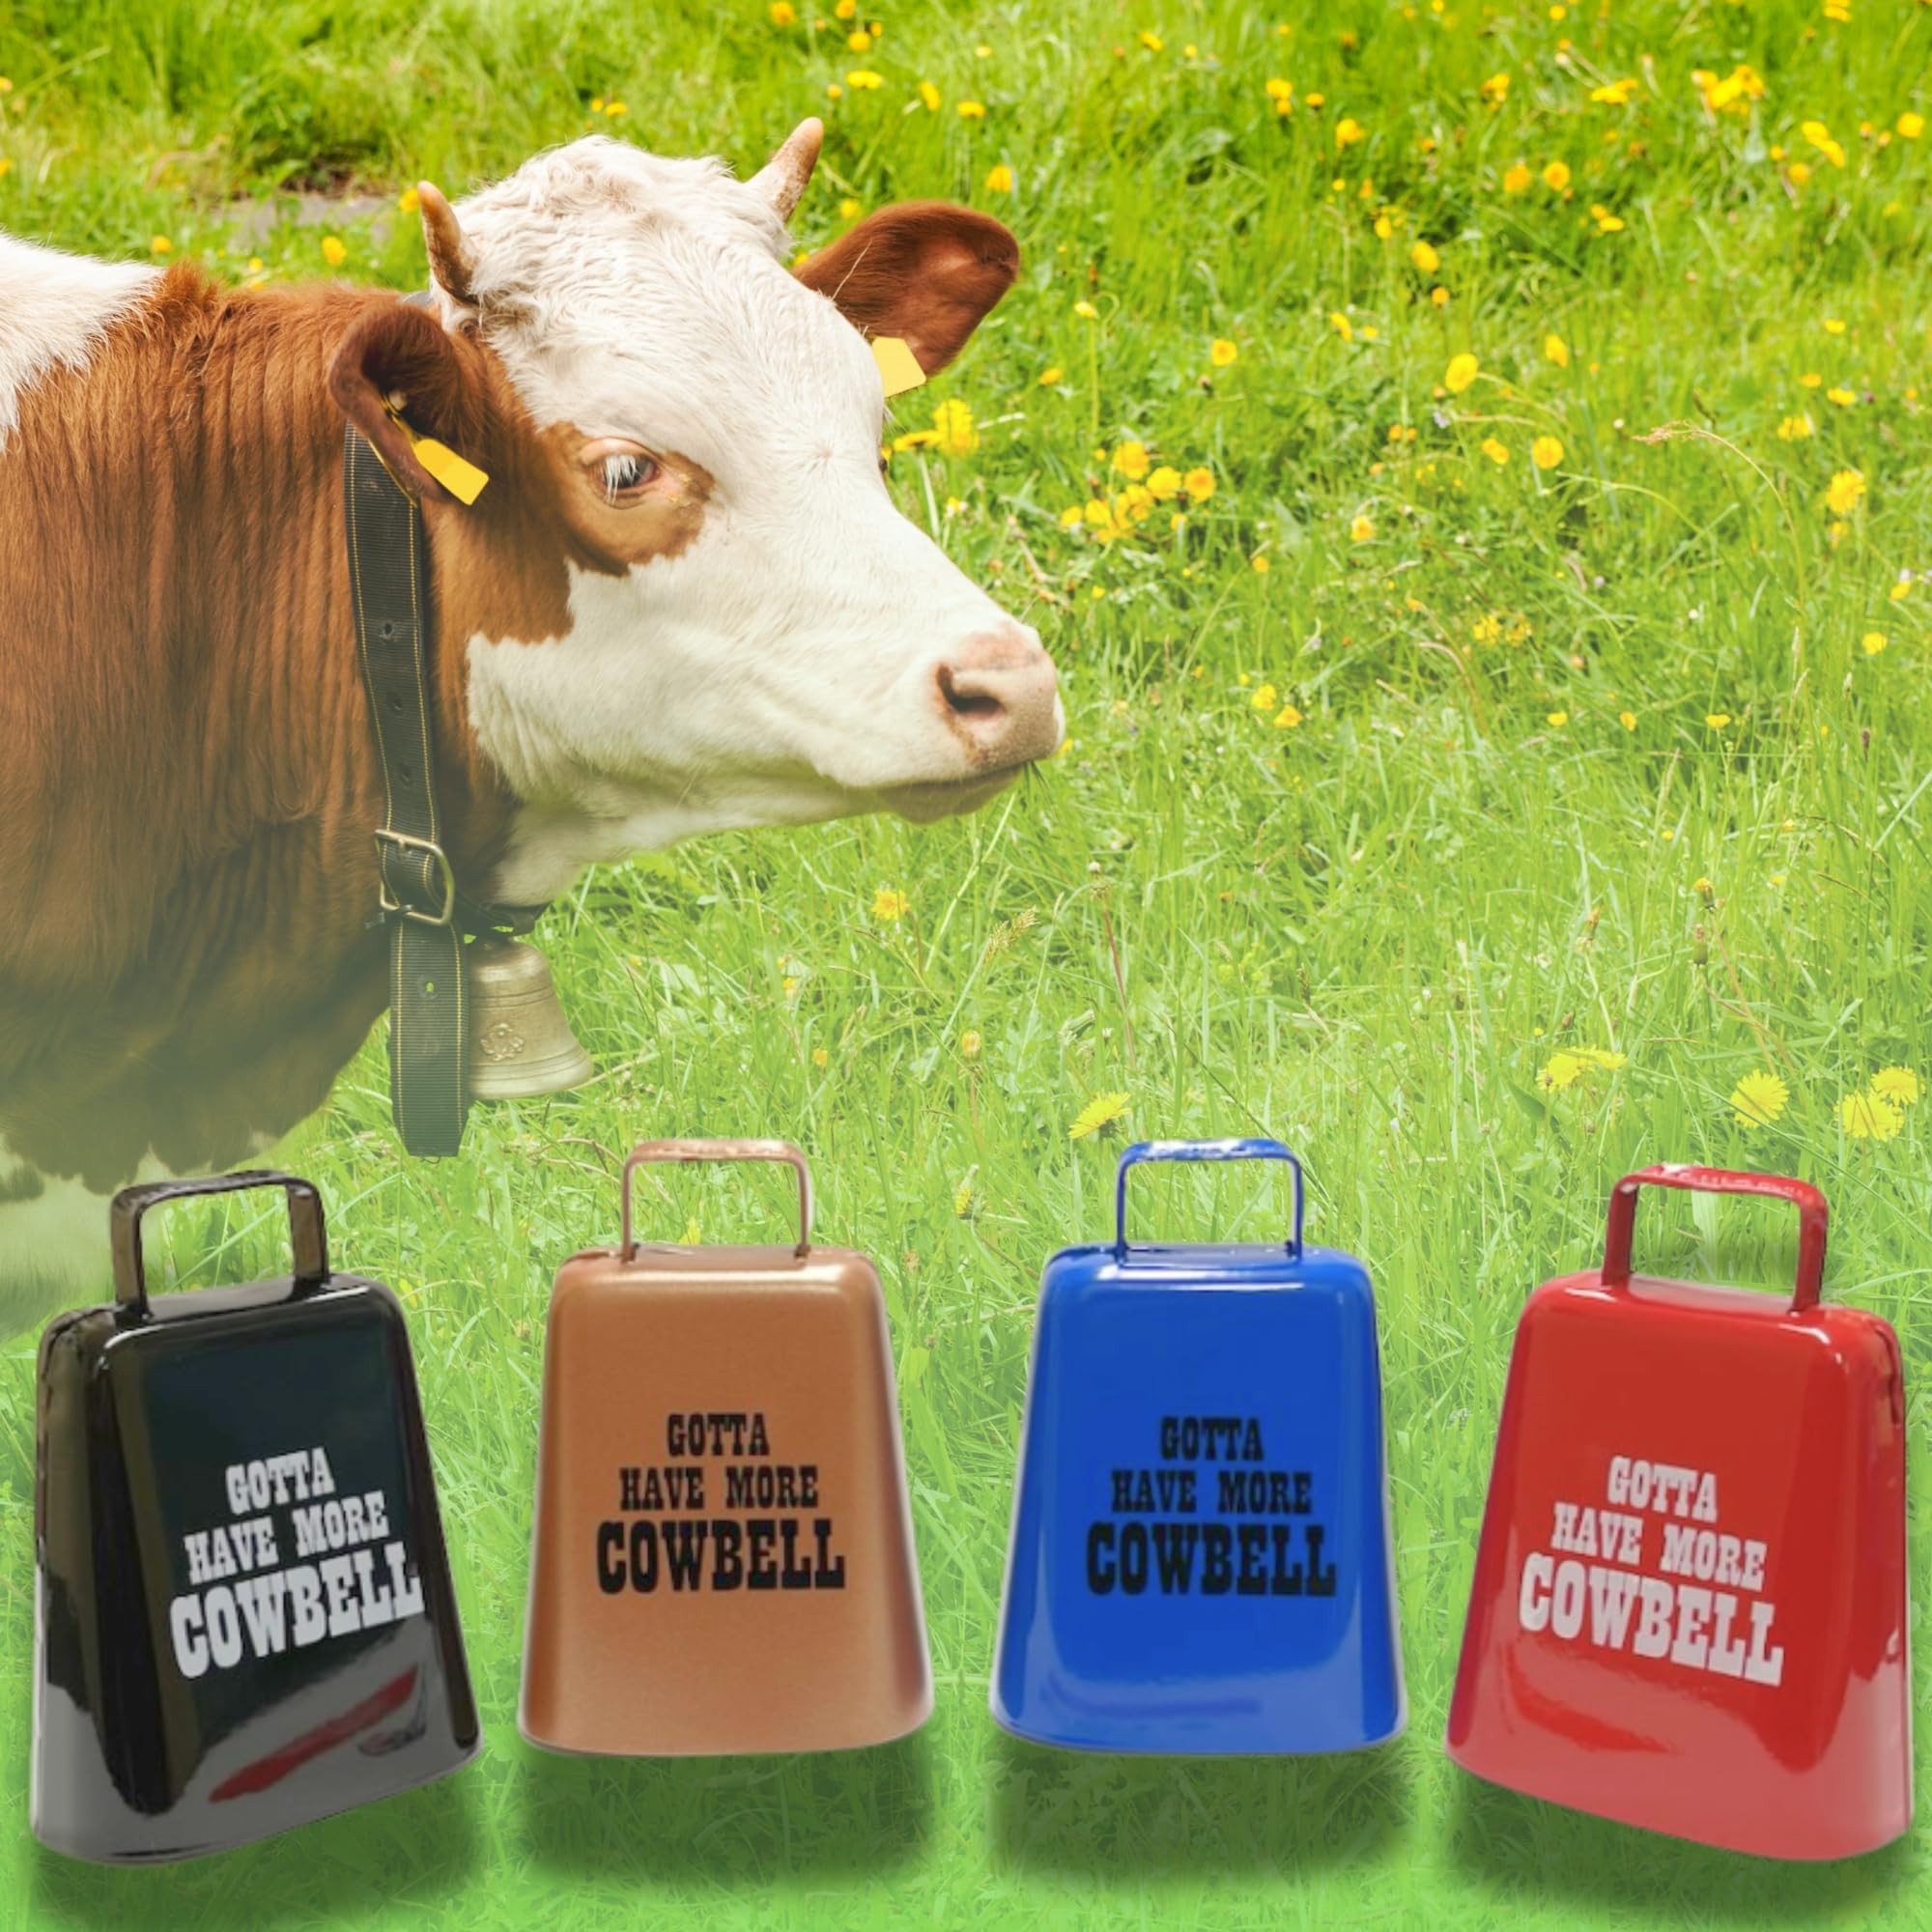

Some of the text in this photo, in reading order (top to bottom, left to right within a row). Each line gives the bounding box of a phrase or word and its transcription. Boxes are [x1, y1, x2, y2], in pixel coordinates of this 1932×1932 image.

[667, 1412, 771, 1457] GOTTA
[1160, 1415, 1264, 1462] GOTTA
[225, 1446, 334, 1516] GOTTA
[619, 1464, 819, 1512] HAVE MORE
[1111, 1468, 1312, 1515] HAVE MORE
[1606, 1455, 1719, 1524] GOTTA
[184, 1490, 389, 1585] HAVE MORE
[596, 1518, 845, 1595] COWBELL
[1086, 1520, 1337, 1598] COWBELL
[1550, 1500, 1768, 1593] HAVE MORE
[170, 1542, 425, 1680] COWBELL
[1519, 1551, 1784, 1688] COWBELL
